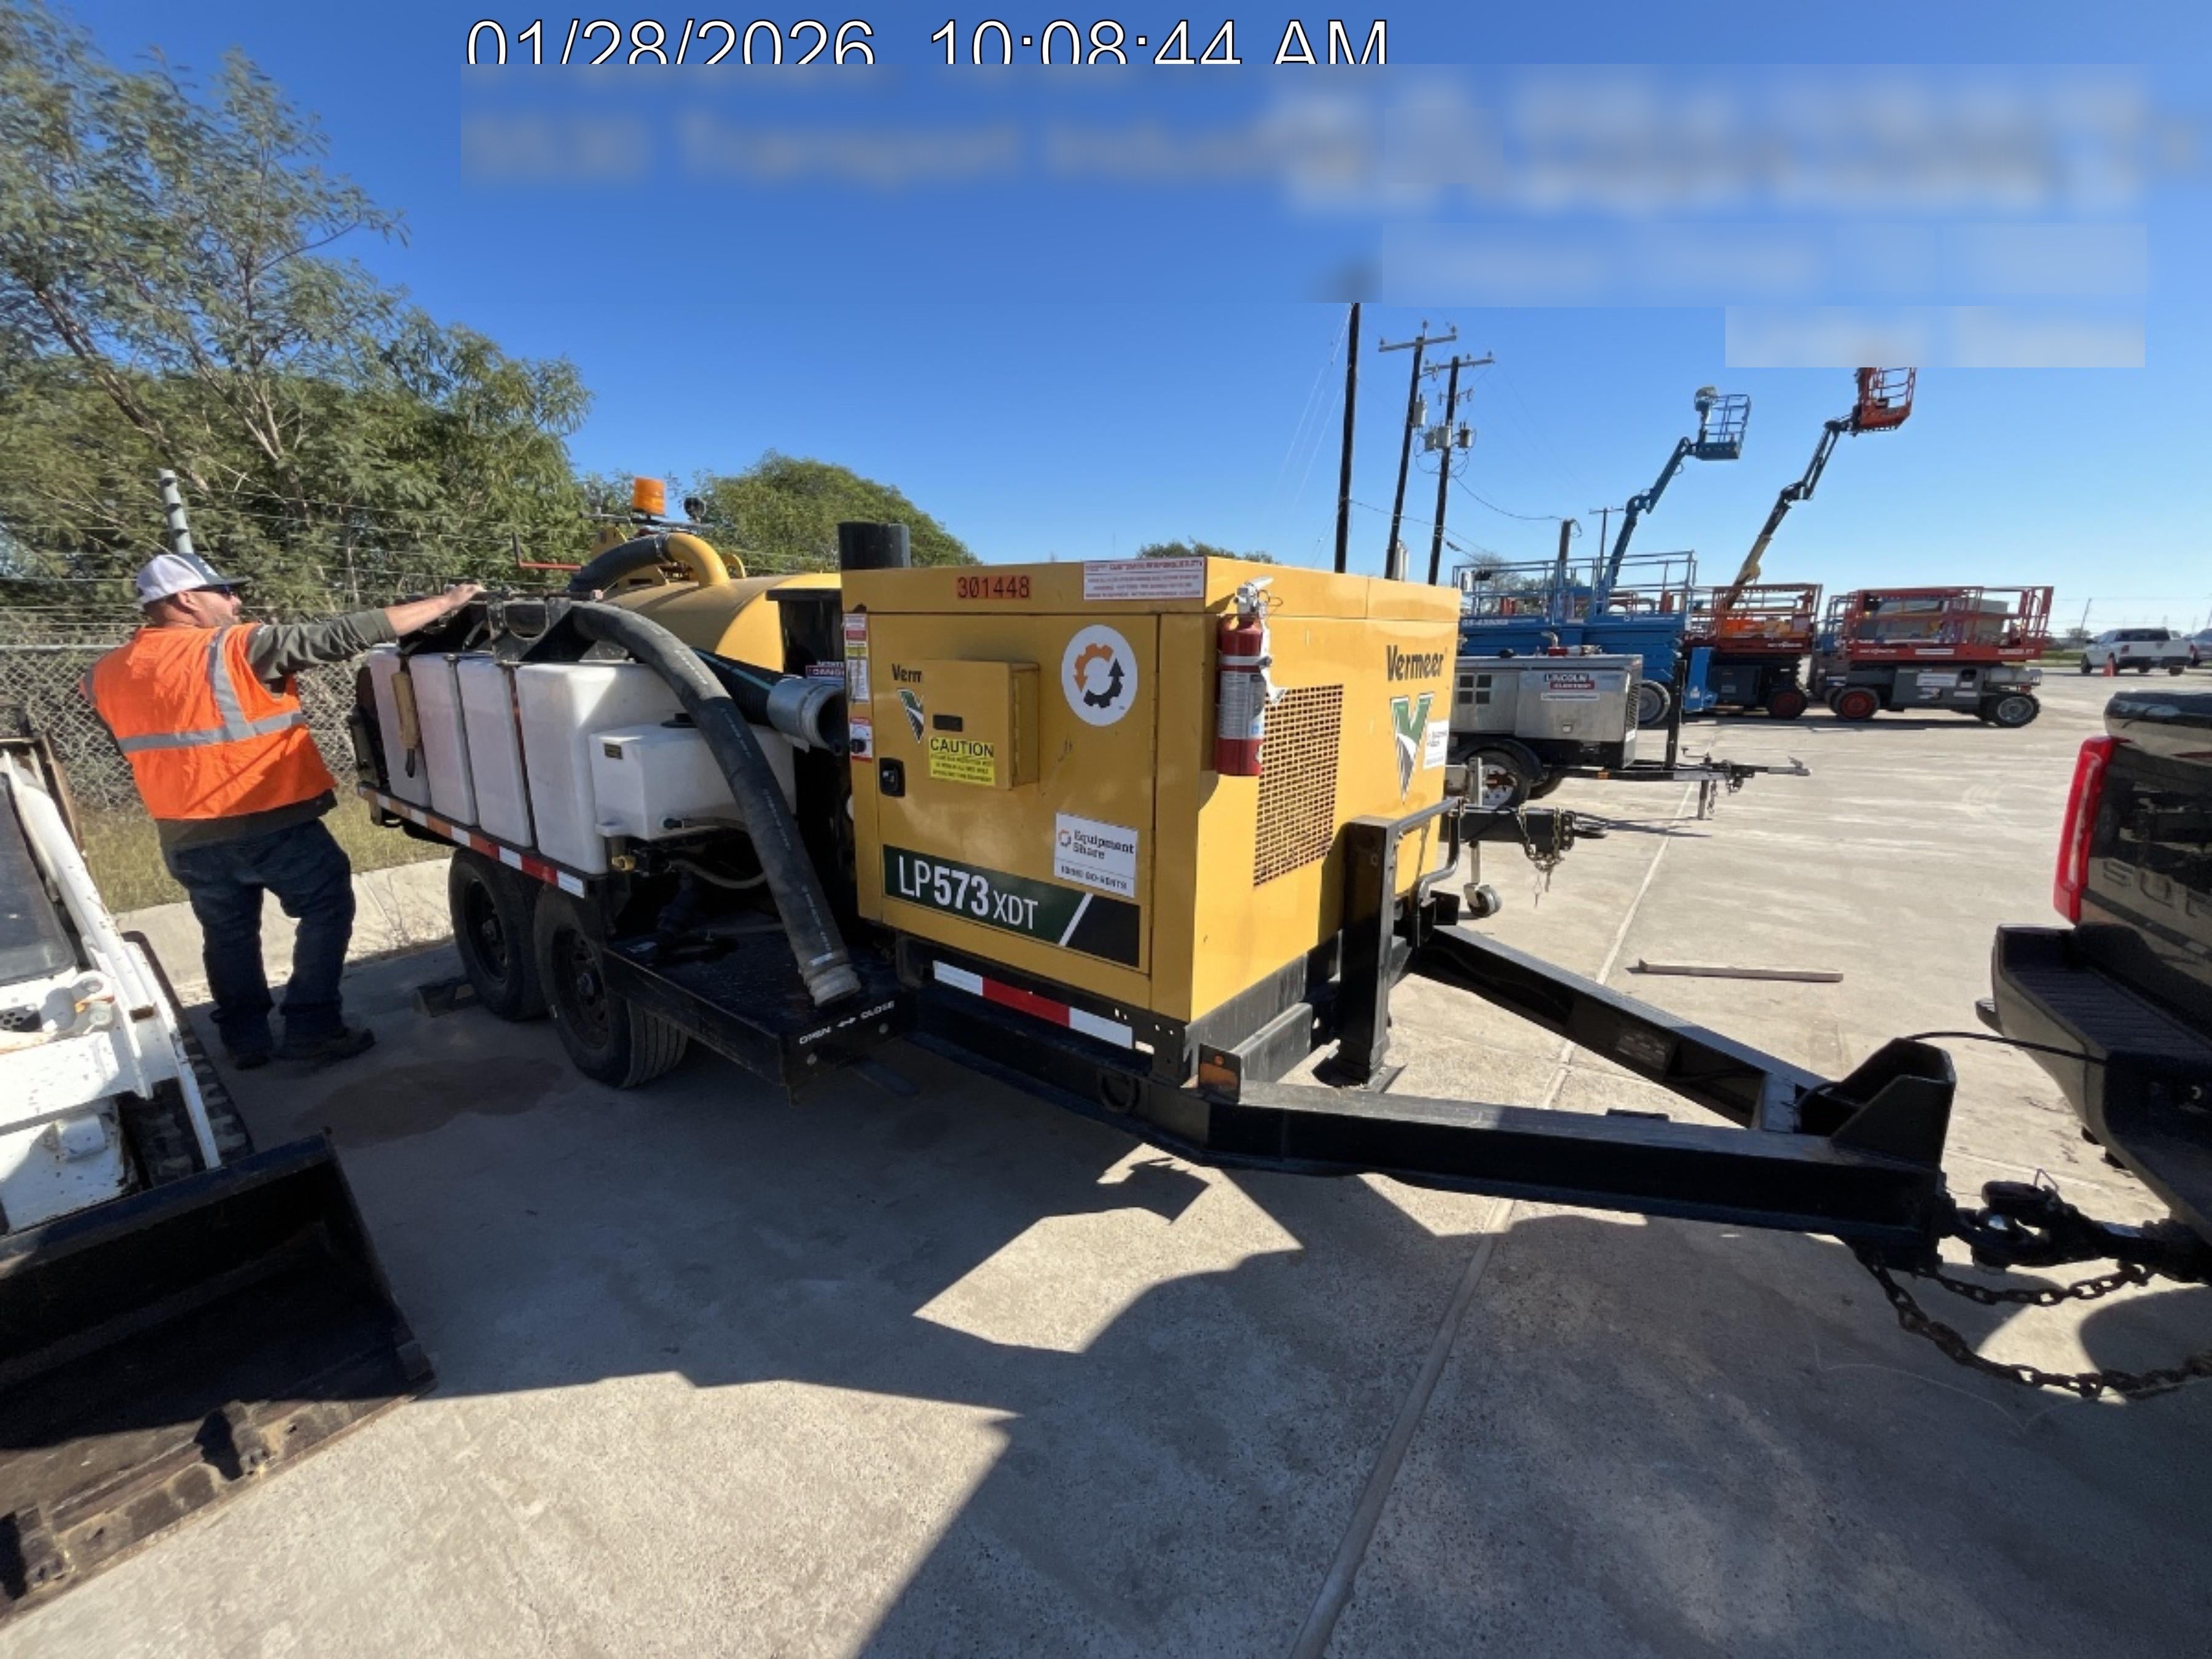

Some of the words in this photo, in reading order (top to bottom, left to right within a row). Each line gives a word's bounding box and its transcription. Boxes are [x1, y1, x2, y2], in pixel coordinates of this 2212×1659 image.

[958, 576, 1029, 598] 301448
[1387, 645, 1444, 681] Vermeer
[930, 738, 994, 757] CAUTION
[1073, 842, 1105, 860] Share
[1074, 830, 1134, 854] Equipment
